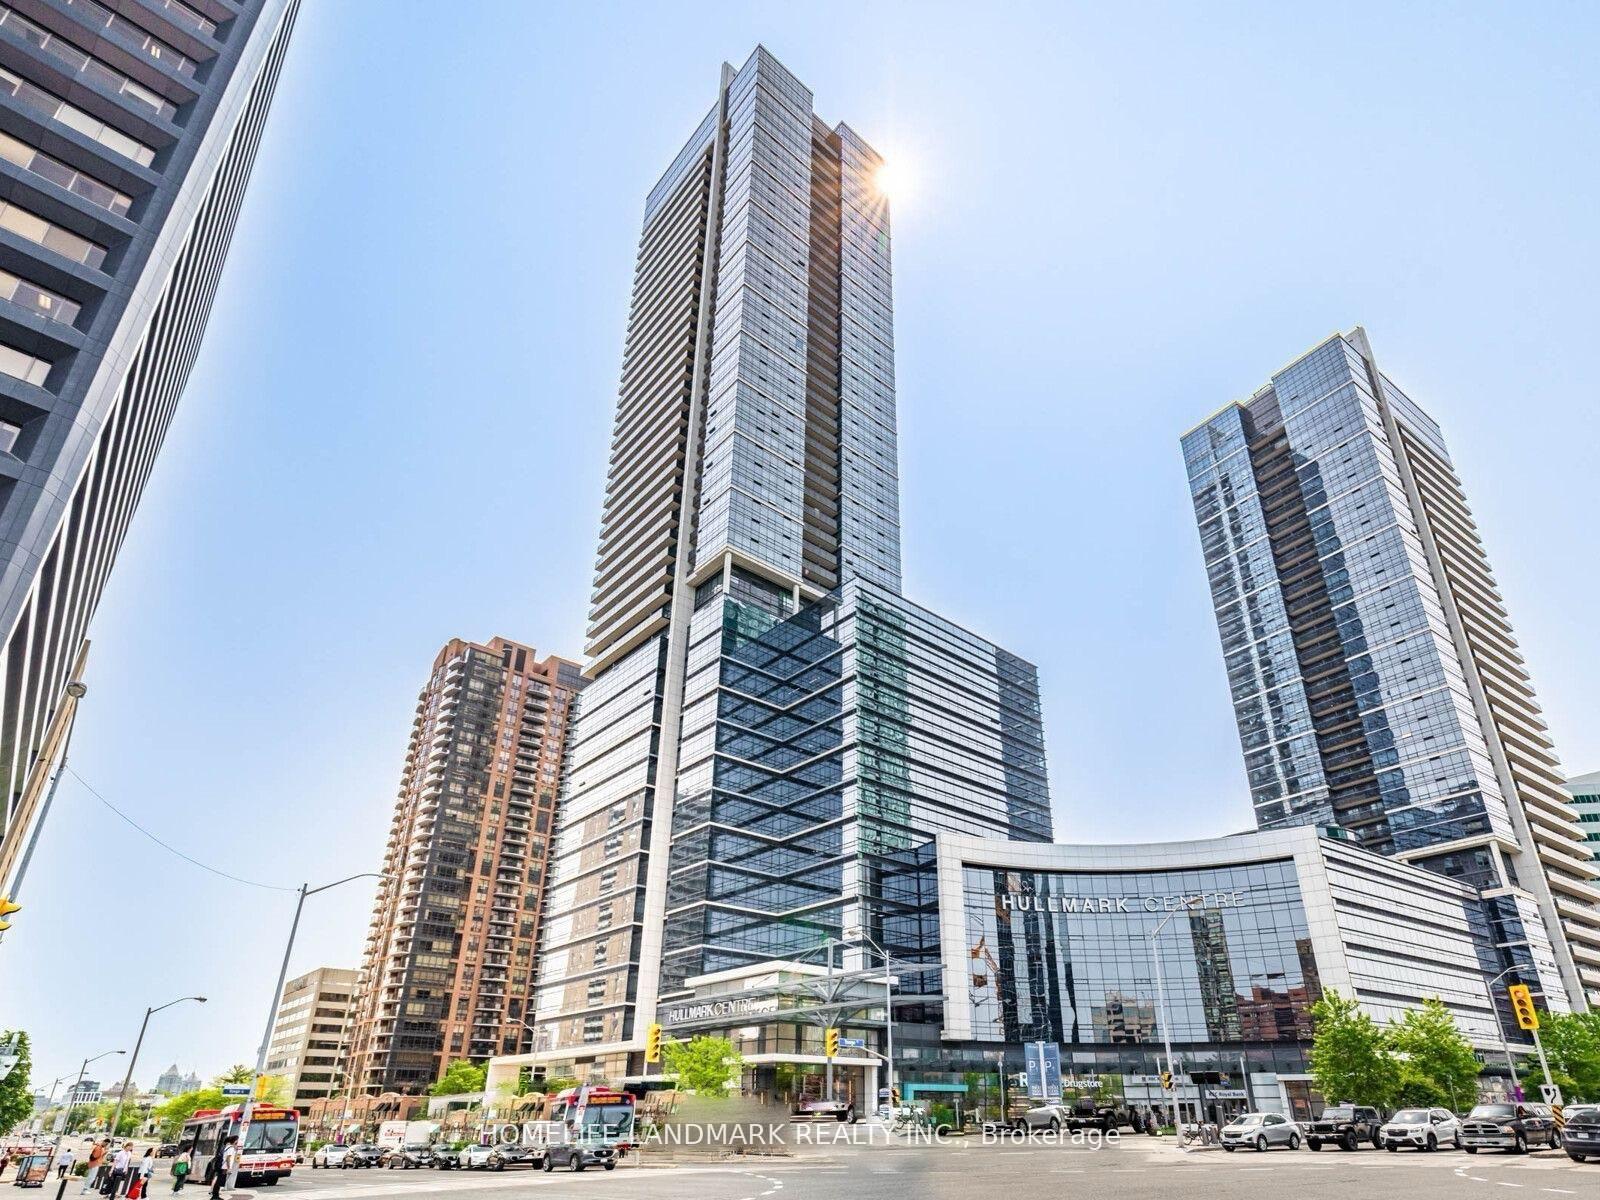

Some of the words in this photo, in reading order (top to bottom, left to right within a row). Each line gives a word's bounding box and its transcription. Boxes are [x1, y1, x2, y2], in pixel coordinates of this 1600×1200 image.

[1001, 894, 1129, 913] HULLMARK
[1144, 891, 1246, 912] CENTRE
[668, 1003, 714, 1022] HULLMARK
[1064, 1080, 1103, 1089] Drugstore
